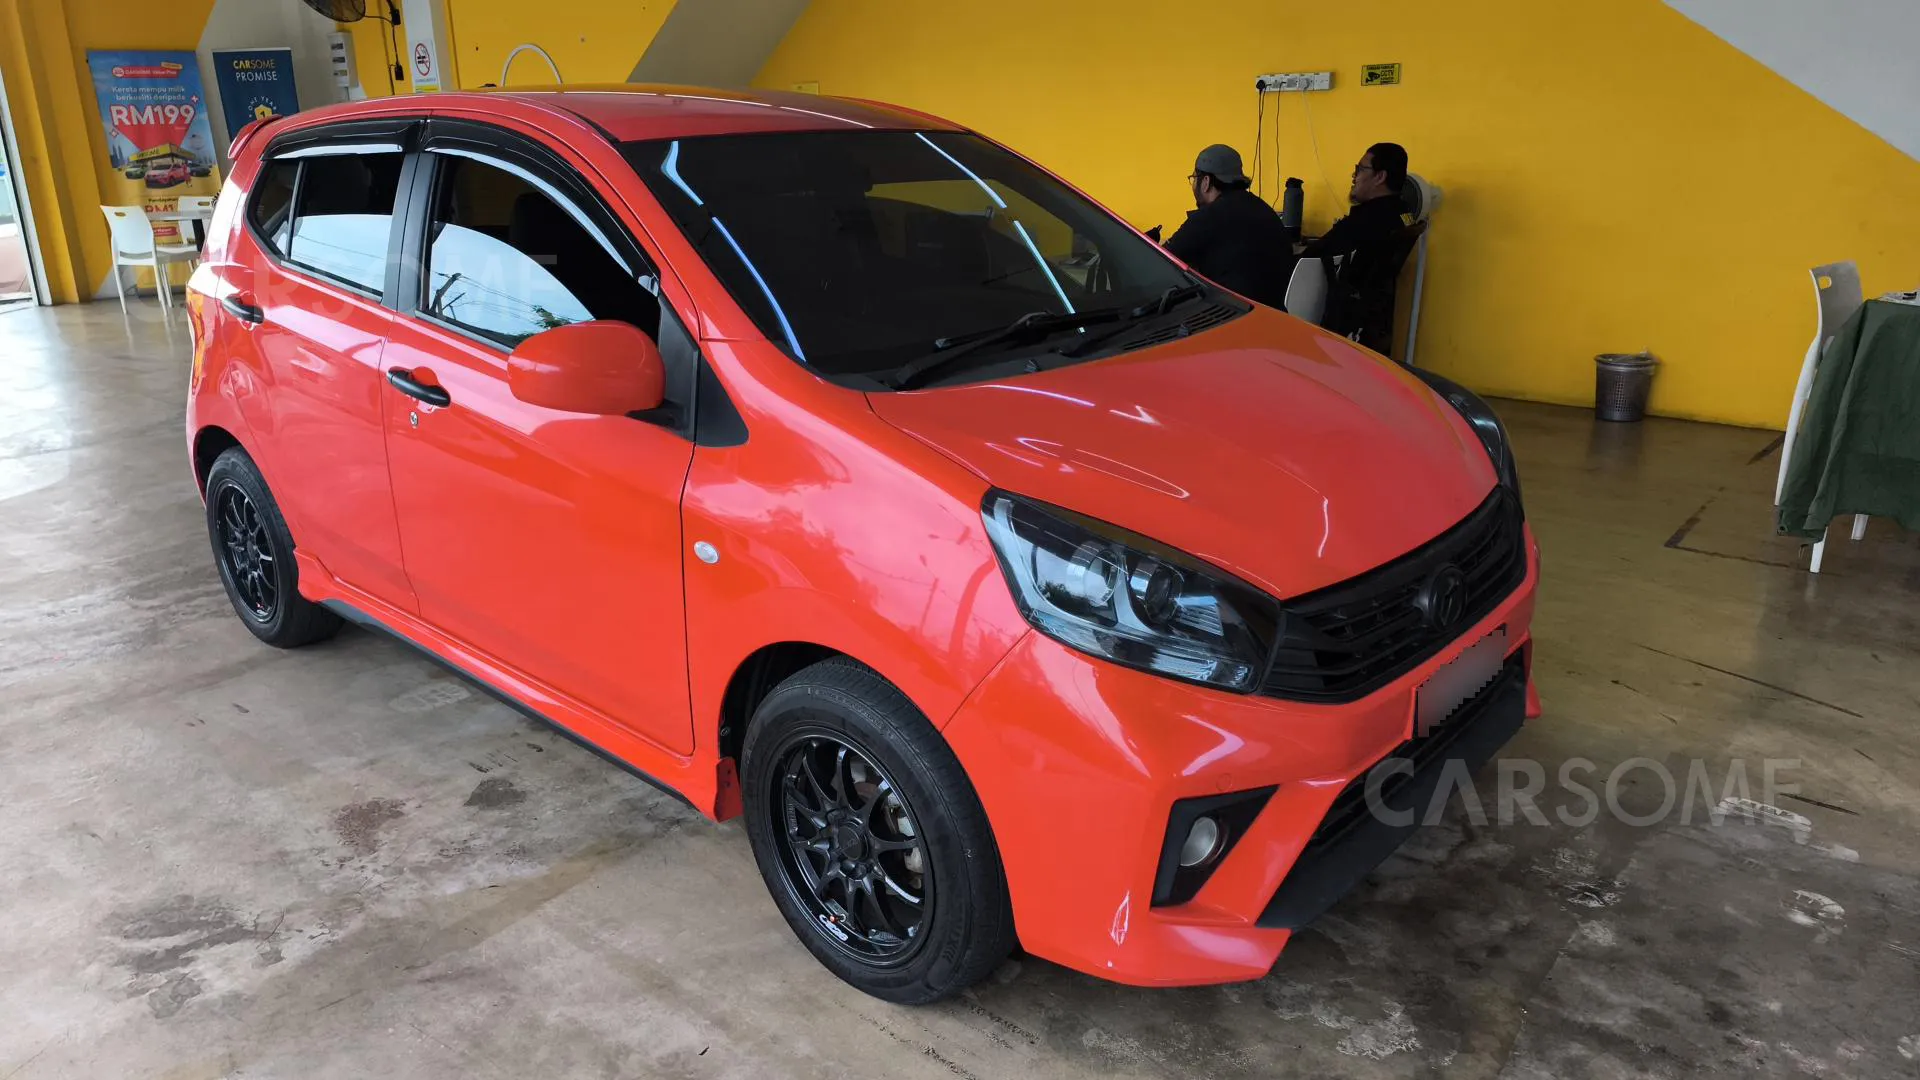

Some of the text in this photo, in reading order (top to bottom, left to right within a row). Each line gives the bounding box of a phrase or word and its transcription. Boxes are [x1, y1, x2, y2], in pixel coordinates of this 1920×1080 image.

[233, 59, 276, 69] CARSOME
[235, 70, 278, 81] PROMISE
[110, 103, 195, 126] RM199
